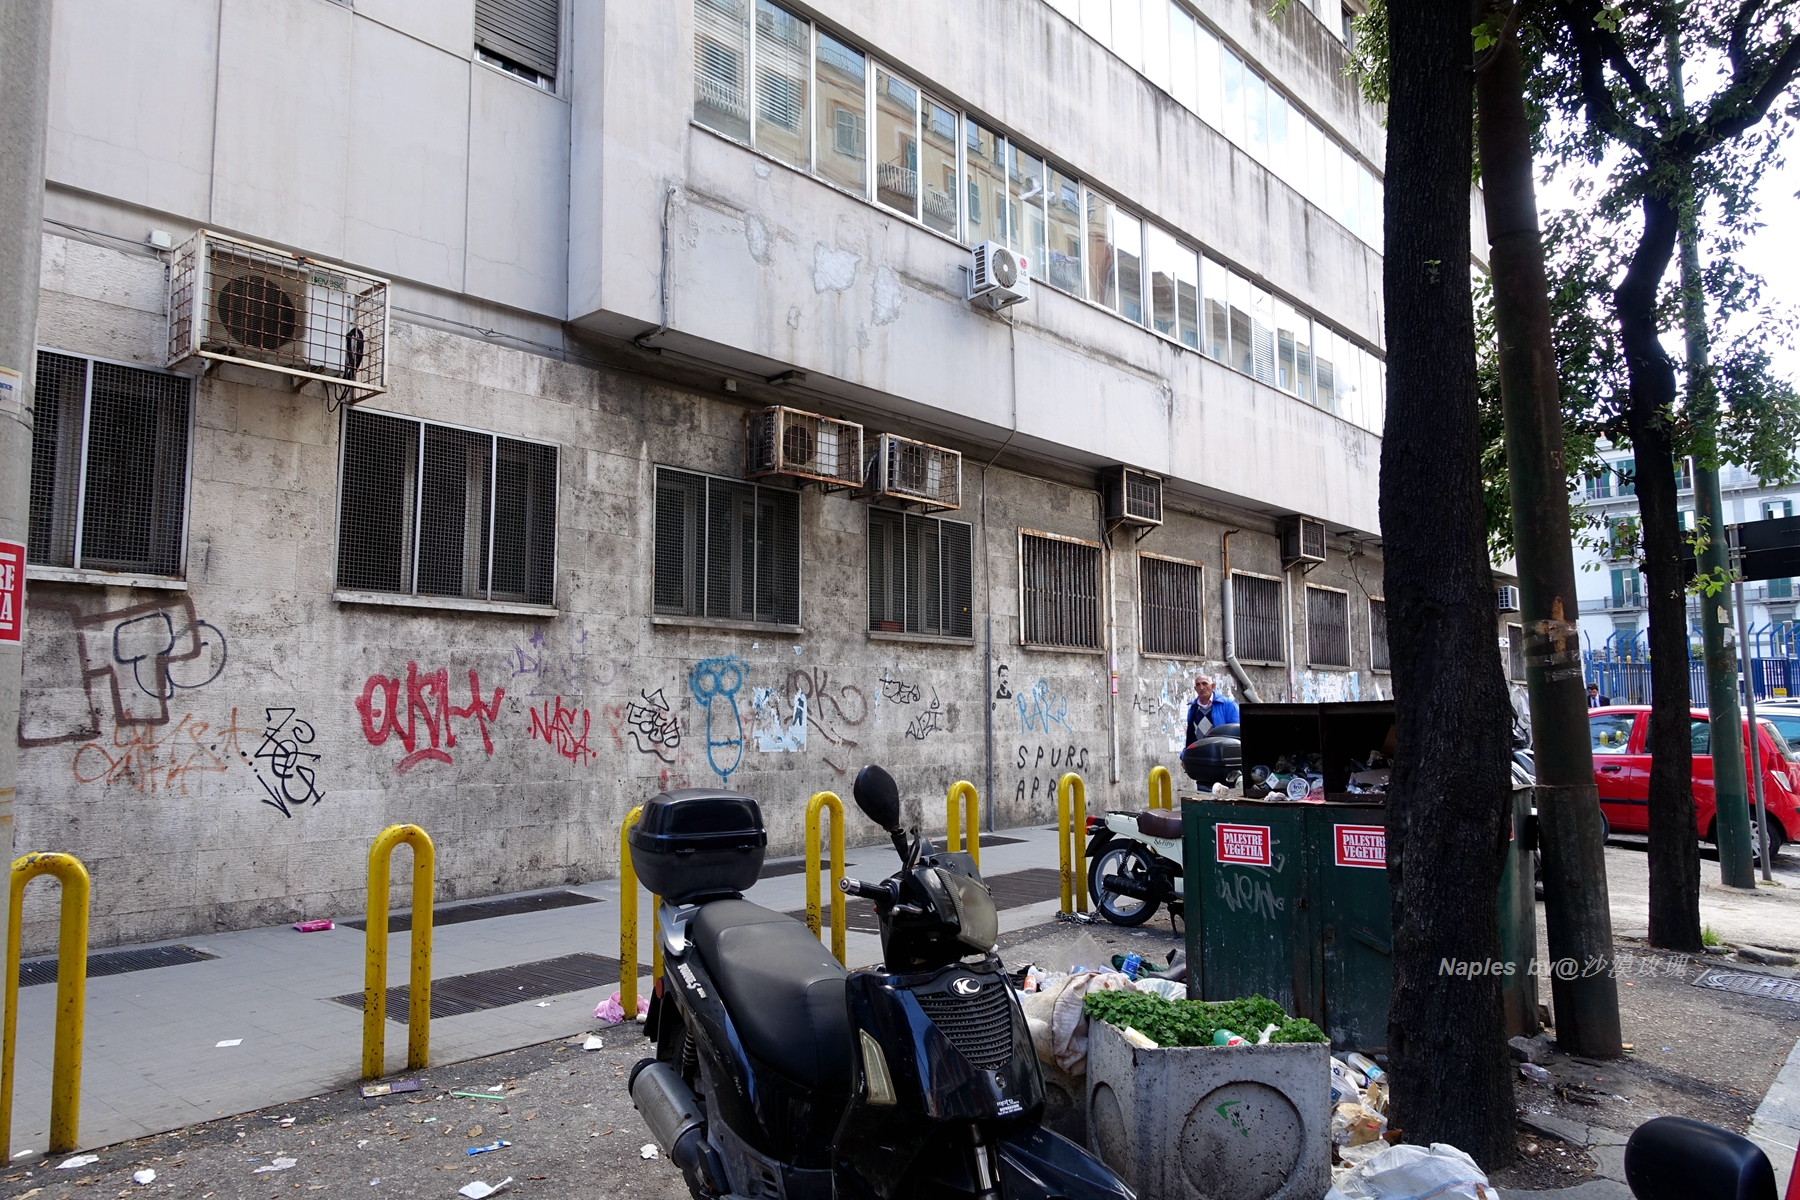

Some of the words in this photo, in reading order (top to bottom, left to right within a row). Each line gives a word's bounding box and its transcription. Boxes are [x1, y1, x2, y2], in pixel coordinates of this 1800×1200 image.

[0, 592, 13, 621] A
[1223, 832, 1263, 846] PALESTRE
[1223, 844, 1263, 857] VEGETHA
